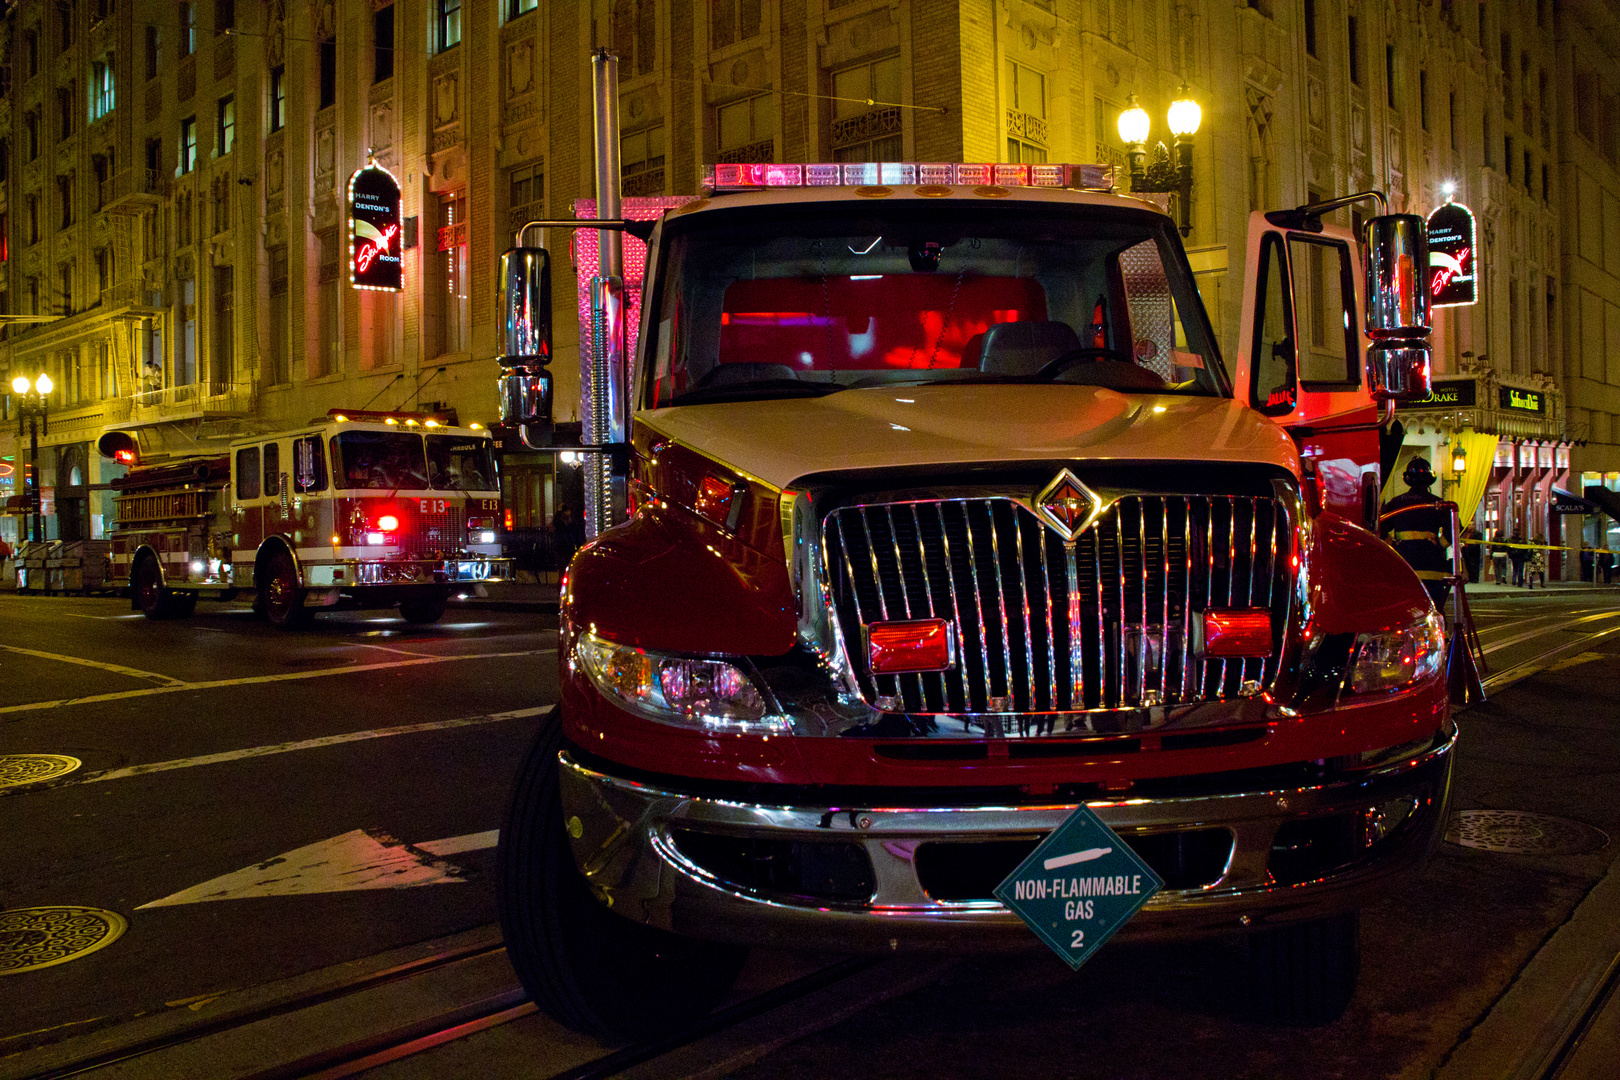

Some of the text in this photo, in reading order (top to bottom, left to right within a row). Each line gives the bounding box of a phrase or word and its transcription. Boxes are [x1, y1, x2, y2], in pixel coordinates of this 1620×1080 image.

[356, 193, 380, 201] HARRY
[355, 203, 390, 213] DENTON'S
[1429, 235, 1462, 244] DENTON'S
[379, 255, 401, 263] ROOM
[420, 500, 445, 513] E 13
[482, 499, 498, 510] E 13
[1015, 875, 1141, 900] NON-FLAMMABLE
[1065, 900, 1094, 921] GAS
[1071, 930, 1084, 949] 2
